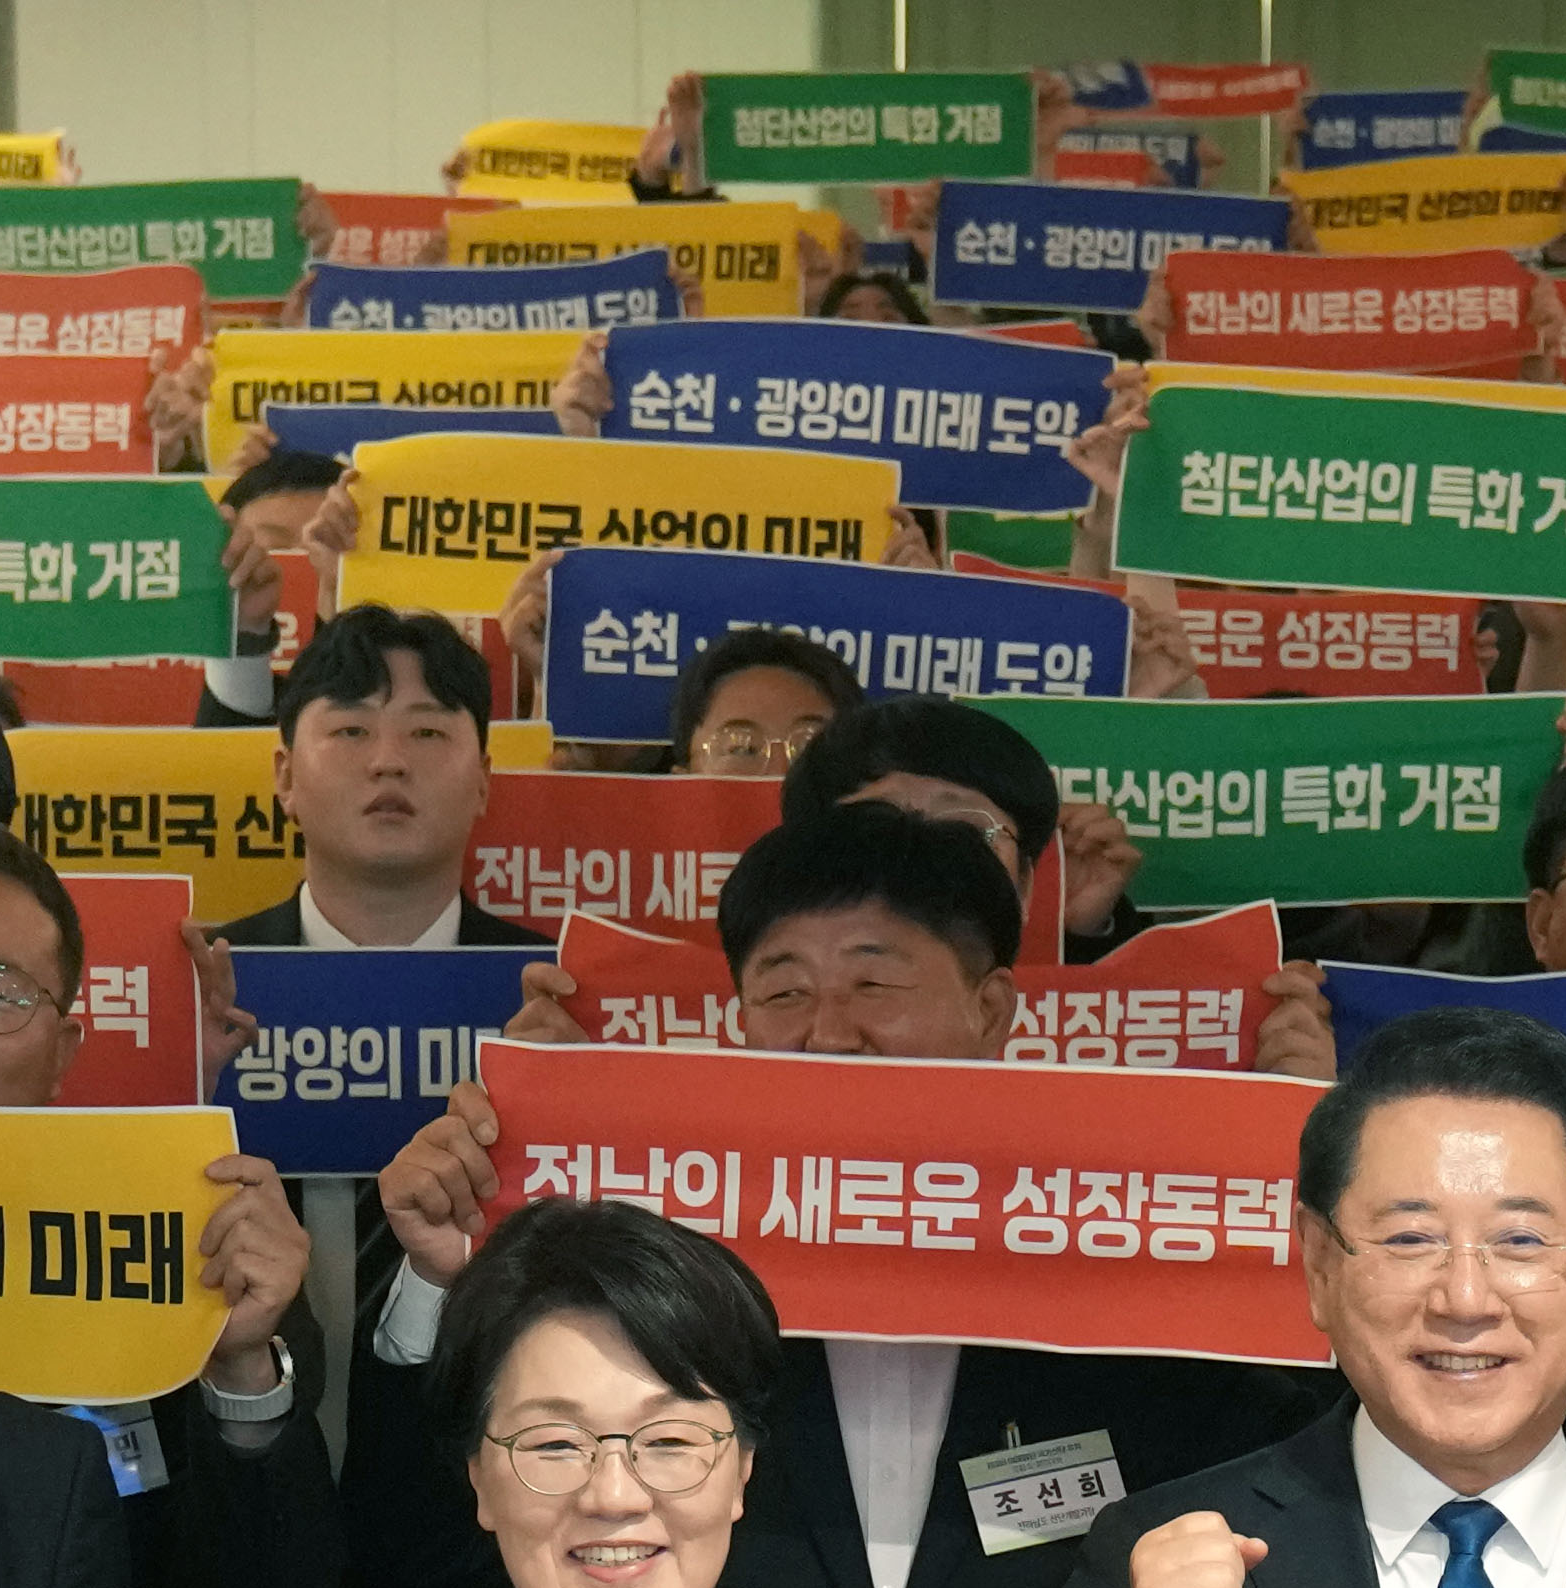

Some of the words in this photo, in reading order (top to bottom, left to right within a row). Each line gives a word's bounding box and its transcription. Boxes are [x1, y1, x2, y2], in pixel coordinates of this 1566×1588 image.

[735, 106, 875, 147] 첨단산업의
[882, 105, 939, 144] 특화
[946, 104, 1001, 143] 거점
[144, 221, 206, 266] 특화
[212, 218, 273, 259] 거점
[956, 221, 1016, 265] 순천
[1045, 226, 1136, 270] 광양의
[57, 306, 185, 354] 성장동력
[1187, 291, 1280, 334] 전남의
[1289, 289, 1383, 334] 새로운
[1393, 286, 1518, 333] 성장동력
[630, 371, 716, 432] 순천
[755, 378, 884, 443] 광양의
[894, 389, 982, 451] 미래
[988, 398, 1082, 458] 도약
[1181, 451, 1417, 524] 첨단산업의
[1427, 465, 1524, 533] 특화
[88, 540, 179, 599] 거점
[583, 609, 678, 676] 순천
[884, 636, 980, 696] 미래
[995, 643, 1094, 696] 도약
[1278, 612, 1459, 671] 성장동력
[1051, 768, 1267, 837] 단산업의
[1281, 763, 1386, 833] 특화
[1399, 764, 1501, 830] 거점
[476, 848, 630, 921] 전남의
[238, 1026, 402, 1100] 광양의
[1014, 989, 1243, 1067] 성장동력
[760, 1156, 980, 1250] 새로운
[1003, 1167, 1293, 1265] 성장동력
[30, 1212, 185, 1305] 미래
